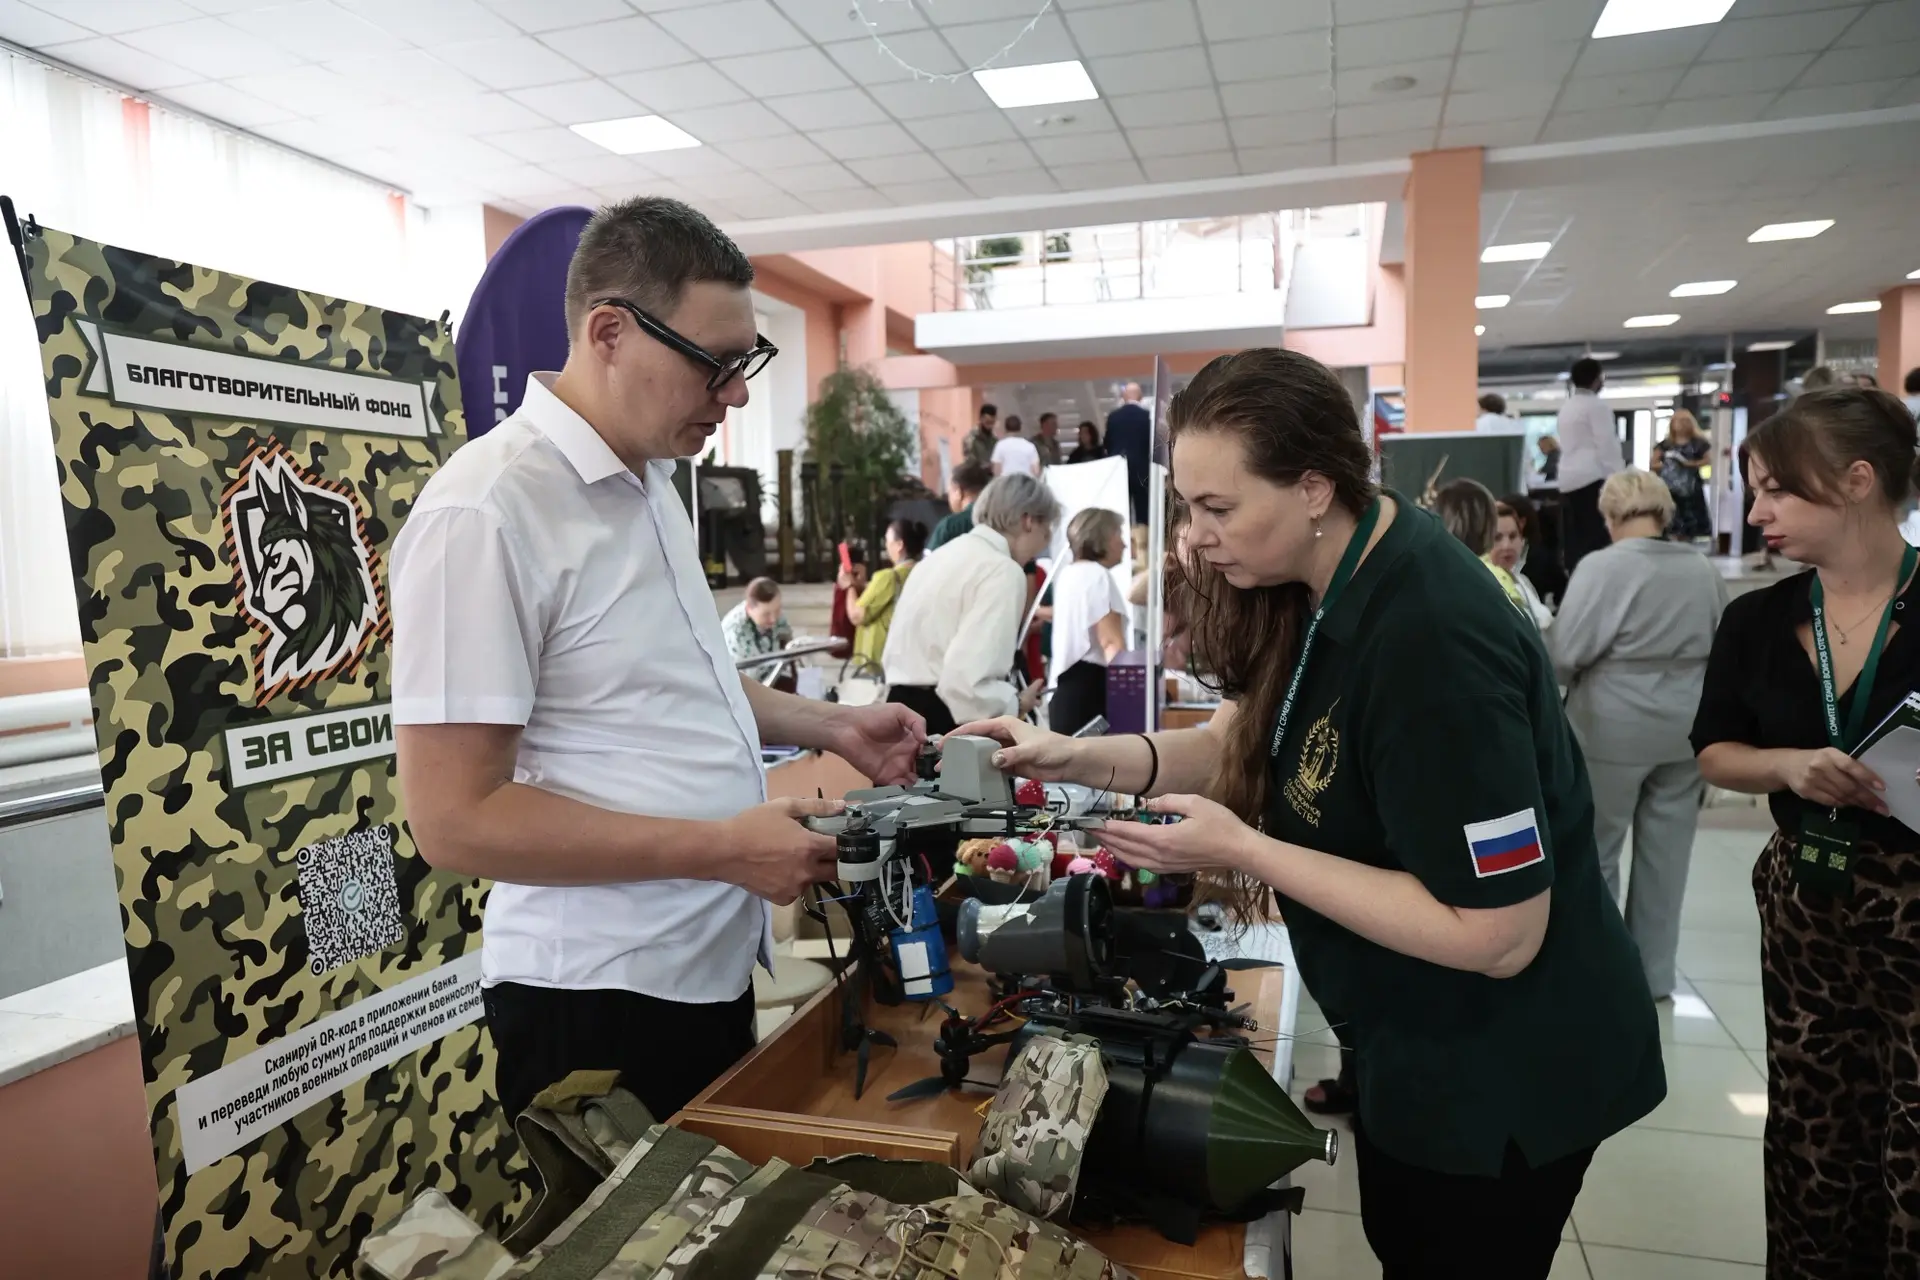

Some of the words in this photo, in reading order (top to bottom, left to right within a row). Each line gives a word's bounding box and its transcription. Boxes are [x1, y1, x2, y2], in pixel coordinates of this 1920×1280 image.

[126, 363, 360, 412] БЛАГОТВОРИТЕЛЬНЫЙ
[365, 397, 412, 419] ФОНД
[1279, 700, 1292, 727] СЕМЕЙ
[1287, 665, 1303, 701] ВОИНОВ
[1301, 621, 1318, 665] ОТЕЧЕСТВА
[1820, 651, 1831, 679] ВОИНОВ
[1823, 679, 1834, 702] СЕМЕЙ
[242, 730, 293, 770] ЗА
[305, 713, 393, 756] СВОИ
[1826, 703, 1839, 736] КОМИТЕТ
[265, 1036, 317, 1075] Сканируй
[320, 1020, 357, 1046] QR-код
[359, 1016, 365, 1027] в
[367, 986, 430, 1023] приложении
[432, 974, 458, 994] банка
[198, 1114, 208, 1130] и
[211, 1083, 270, 1124] переведи
[272, 1062, 309, 1092] любую
[312, 1043, 345, 1070] сумму
[348, 1032, 367, 1053] для
[369, 1003, 427, 1039] поддержки
[234, 1088, 300, 1136] участников
[302, 1060, 348, 1094] военных
[351, 1030, 399, 1067] операций
[401, 1031, 409, 1042] и
[410, 1013, 445, 1037] членов
[446, 1007, 458, 1020] их
